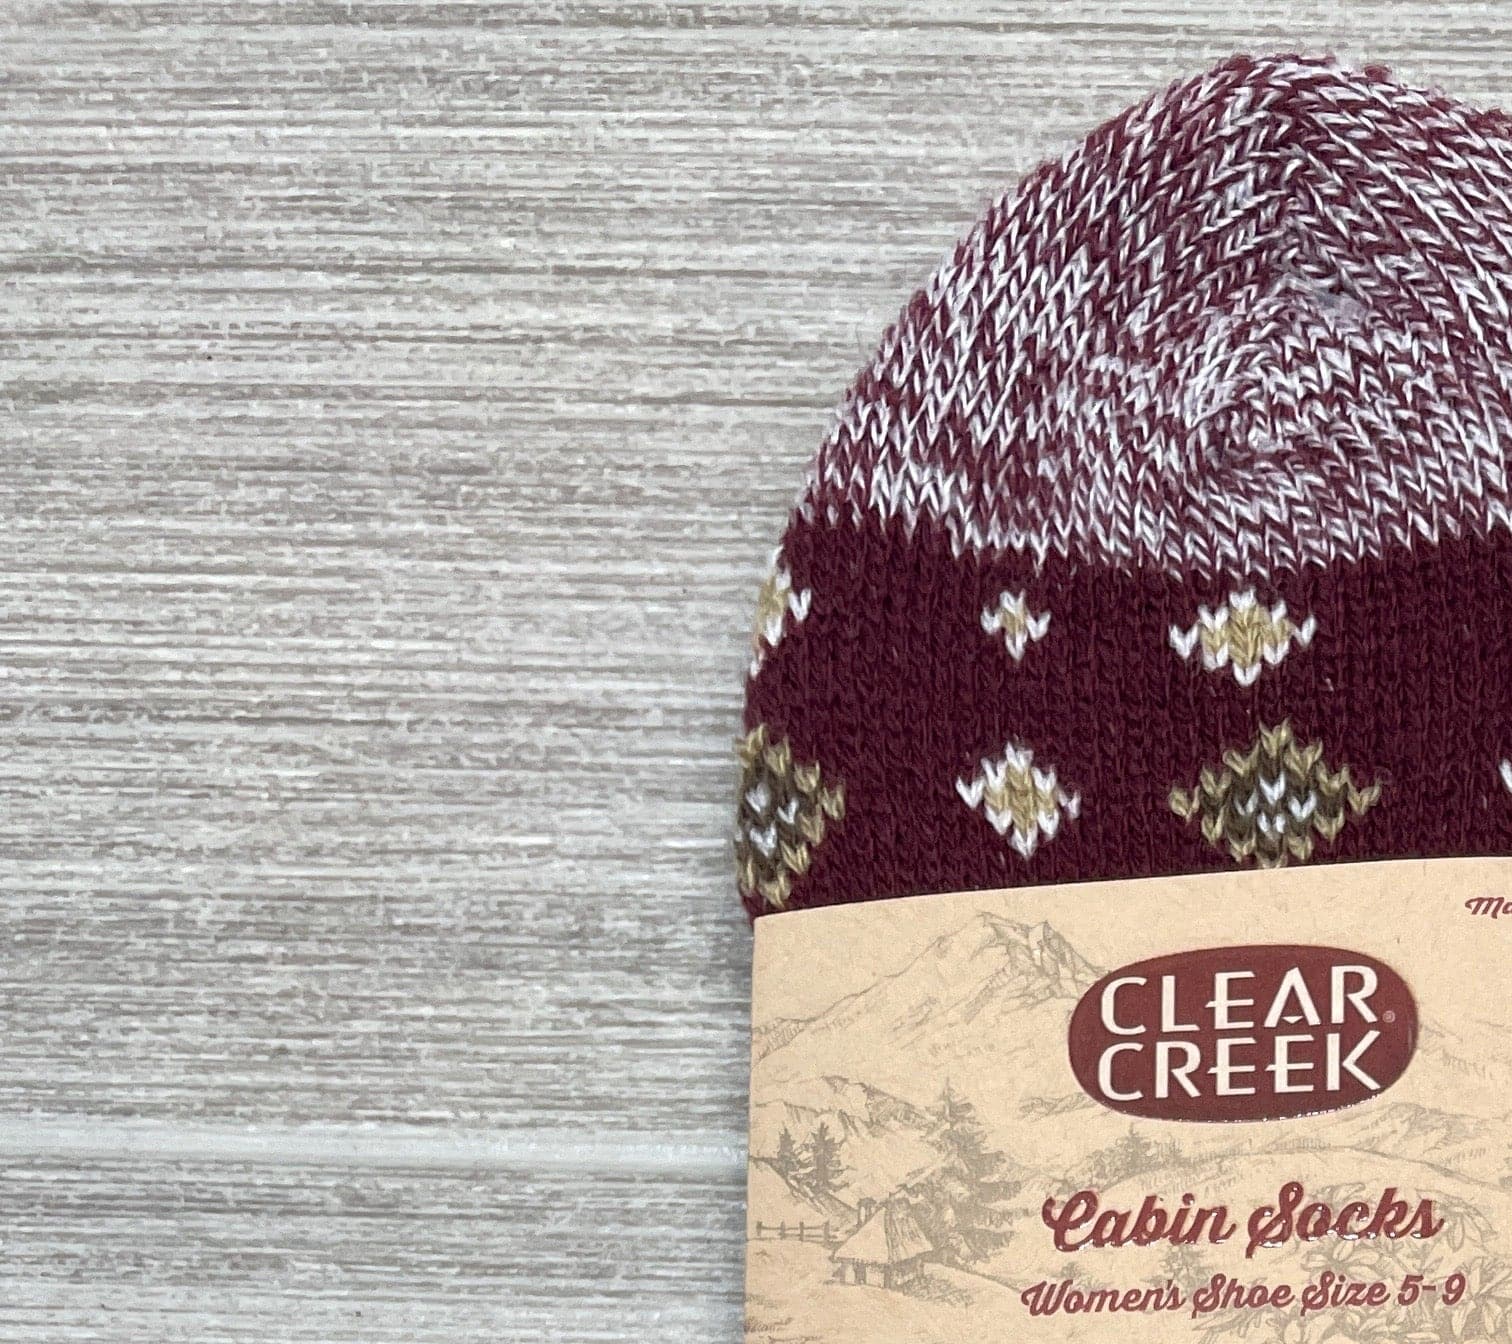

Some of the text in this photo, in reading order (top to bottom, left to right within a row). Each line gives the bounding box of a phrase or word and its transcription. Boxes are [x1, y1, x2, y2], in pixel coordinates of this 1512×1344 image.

[1101, 965, 1378, 1035] CLEAR
[1099, 1030, 1381, 1101] CREEK
[1042, 1181, 1444, 1259] Cabin Socks
[1021, 1271, 1467, 1319] Women's Shoe Size 5-9
